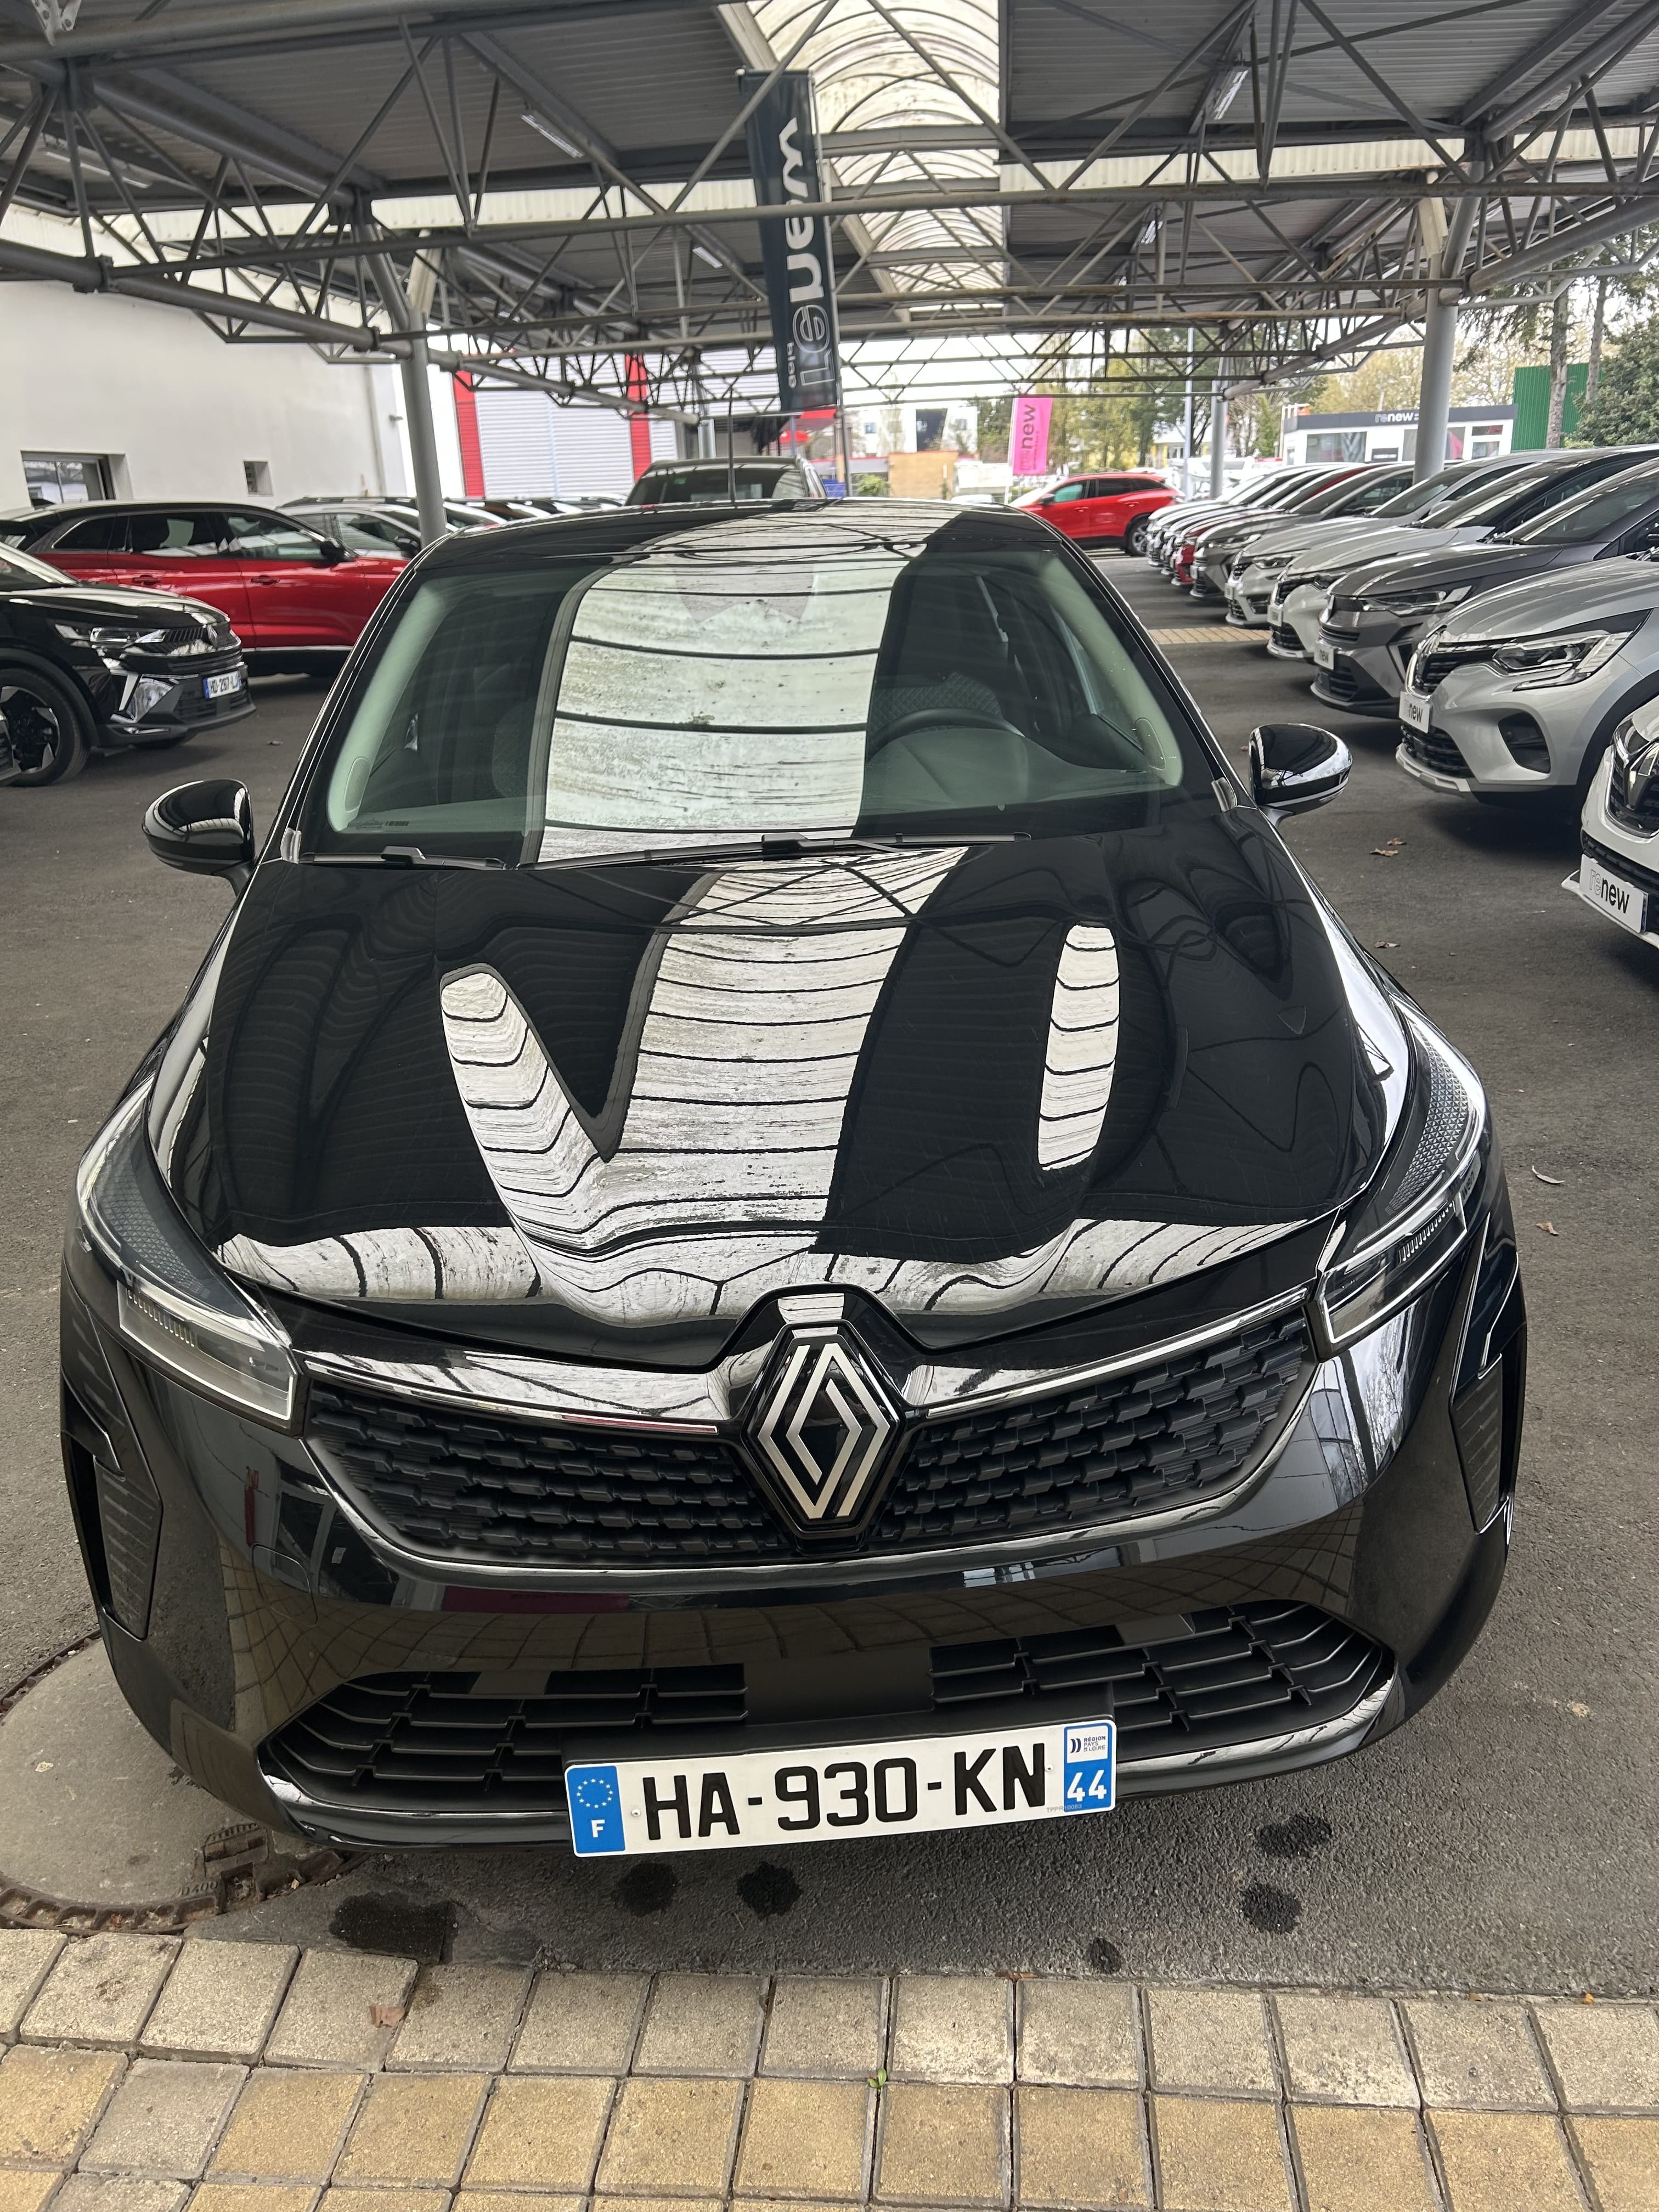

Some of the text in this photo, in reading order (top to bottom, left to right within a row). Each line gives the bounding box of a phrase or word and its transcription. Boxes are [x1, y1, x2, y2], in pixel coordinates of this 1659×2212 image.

[1375, 412, 1414, 423] renew
[1589, 868, 1630, 914] renew
[643, 1742, 1046, 1840] HA-930-KN
[1067, 1769, 1107, 1802] 44
[591, 1819, 605, 1838] F
